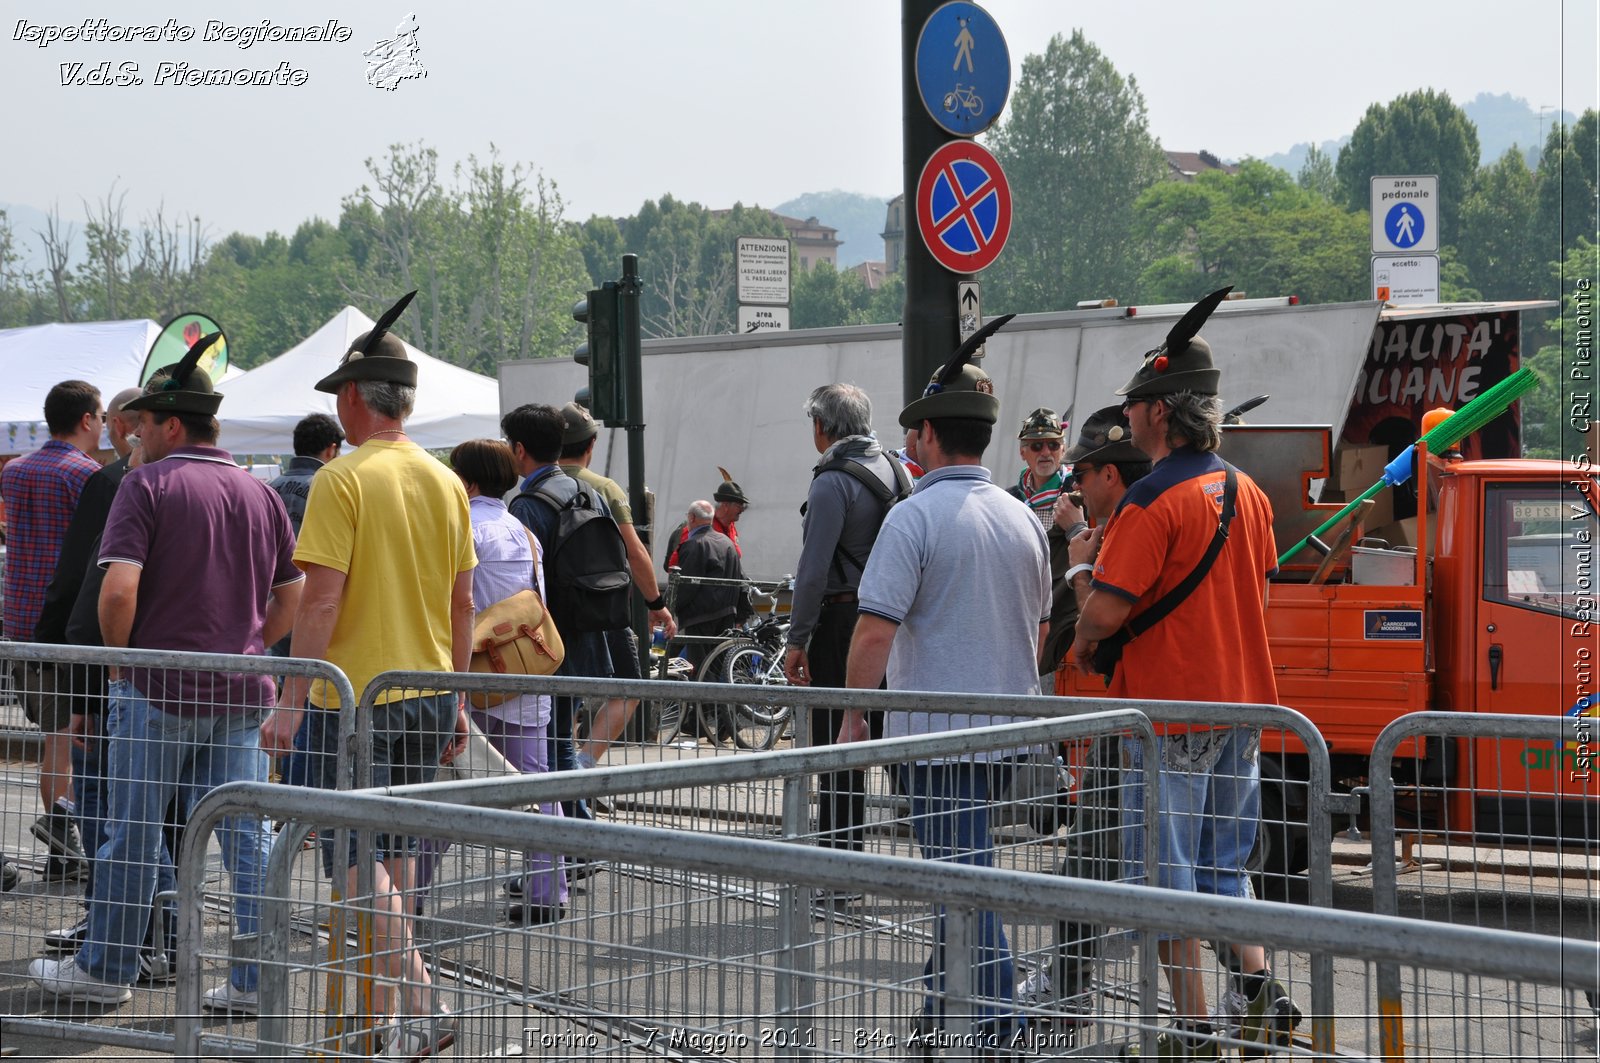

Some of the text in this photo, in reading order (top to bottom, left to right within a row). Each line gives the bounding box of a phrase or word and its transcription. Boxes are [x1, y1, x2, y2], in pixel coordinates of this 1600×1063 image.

[1394, 180, 1417, 188] area
[1382, 190, 1429, 200] pedonale
[740, 243, 787, 253] ATTENZIONE
[755, 311, 773, 319] area
[746, 320, 782, 328] pedonale
[1372, 318, 1501, 364] IALITA'
[1356, 366, 1482, 406] ILIANE
